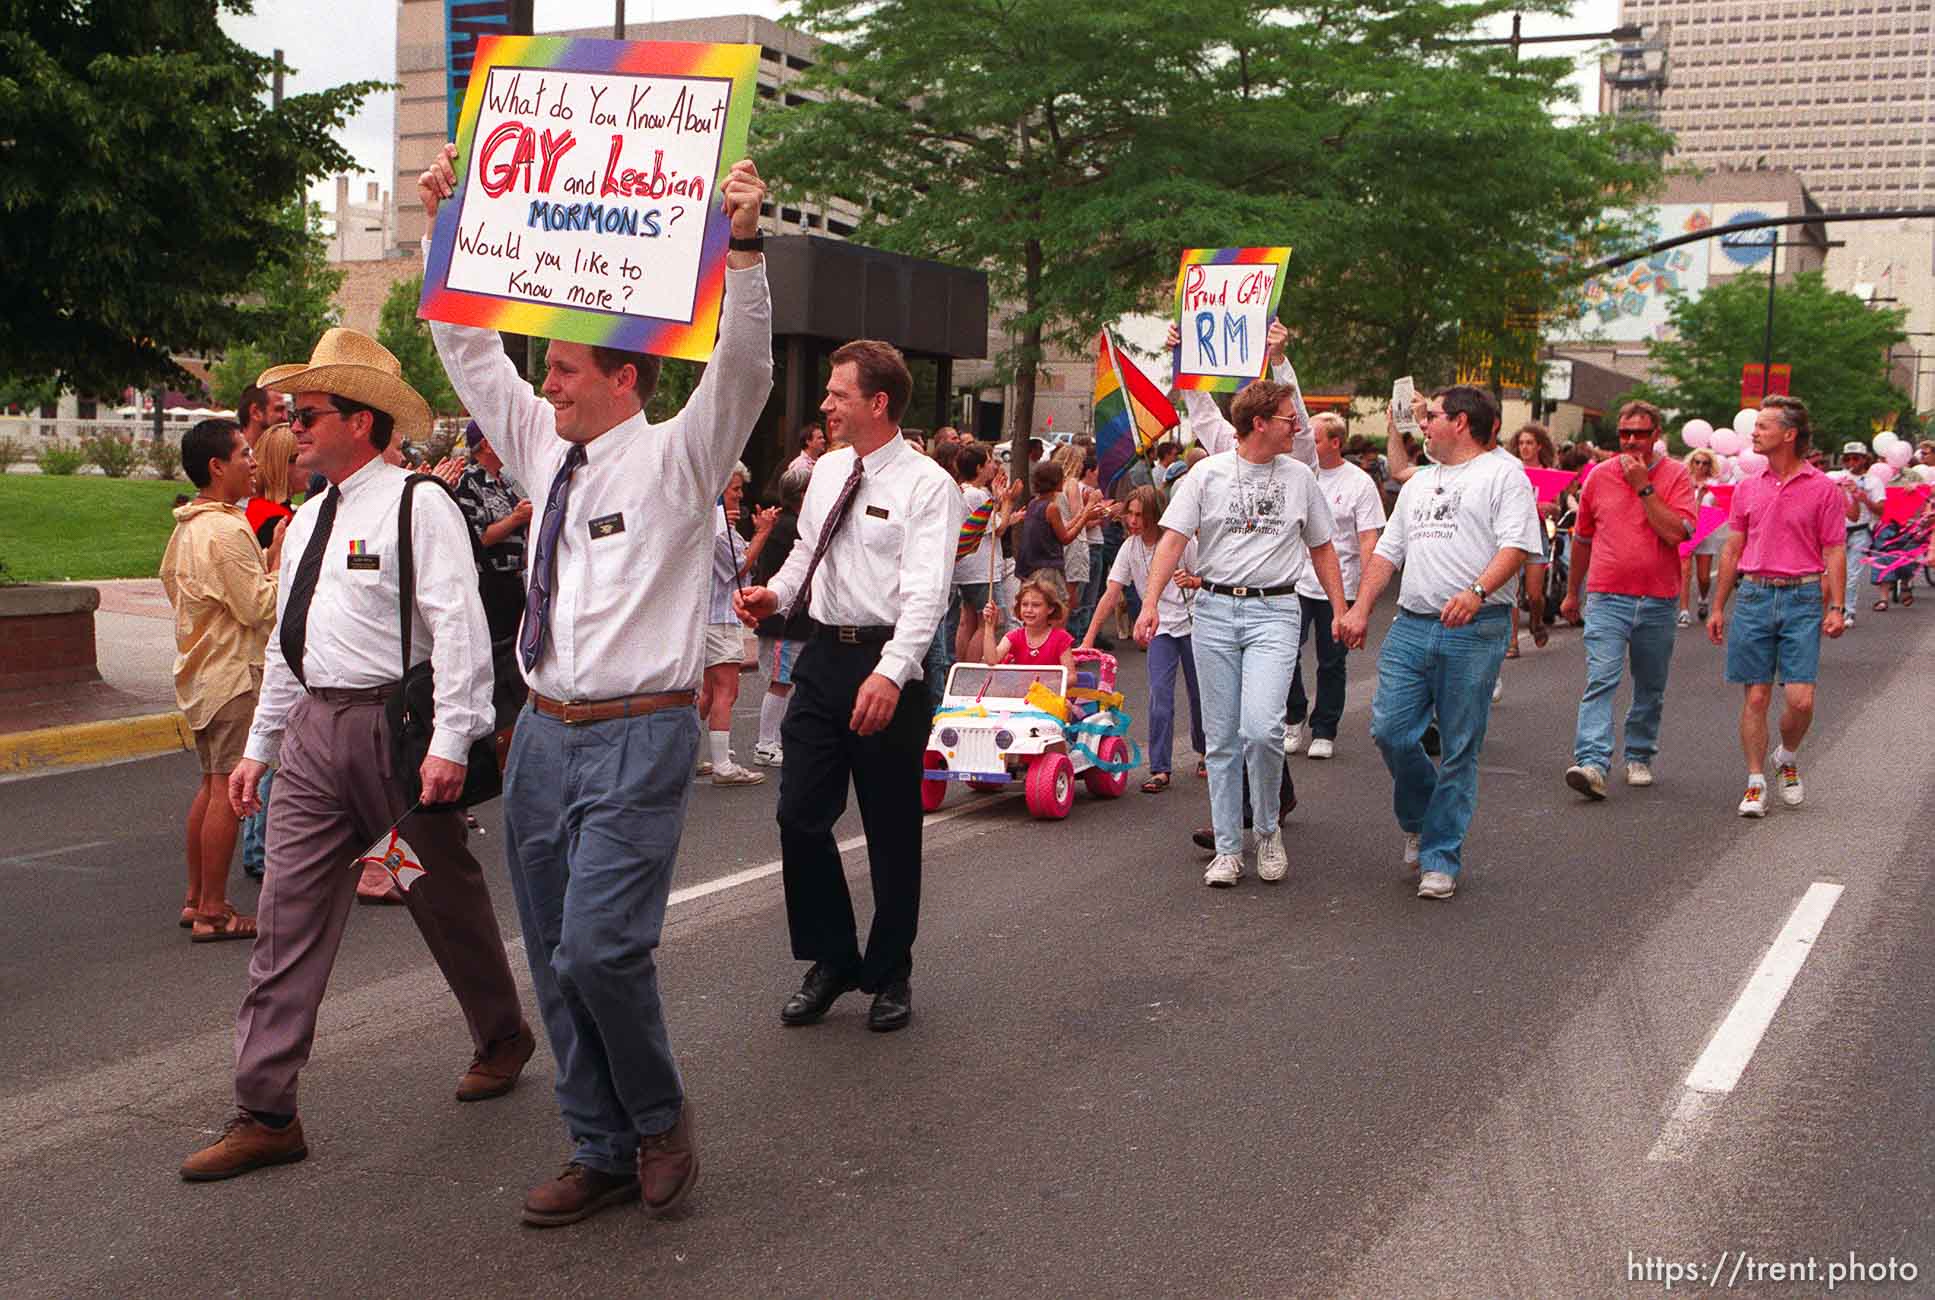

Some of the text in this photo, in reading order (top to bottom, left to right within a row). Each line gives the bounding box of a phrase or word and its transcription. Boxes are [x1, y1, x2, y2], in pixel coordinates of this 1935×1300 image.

[488, 71, 725, 135] What do You Know About
[479, 120, 705, 201] GAY and Lesbian
[458, 222, 521, 261] Would
[534, 249, 562, 275] you
[619, 257, 643, 281] to
[508, 270, 635, 313] Know more?
[1184, 265, 1274, 312] Proud GAY
[1195, 311, 1250, 368] RM
